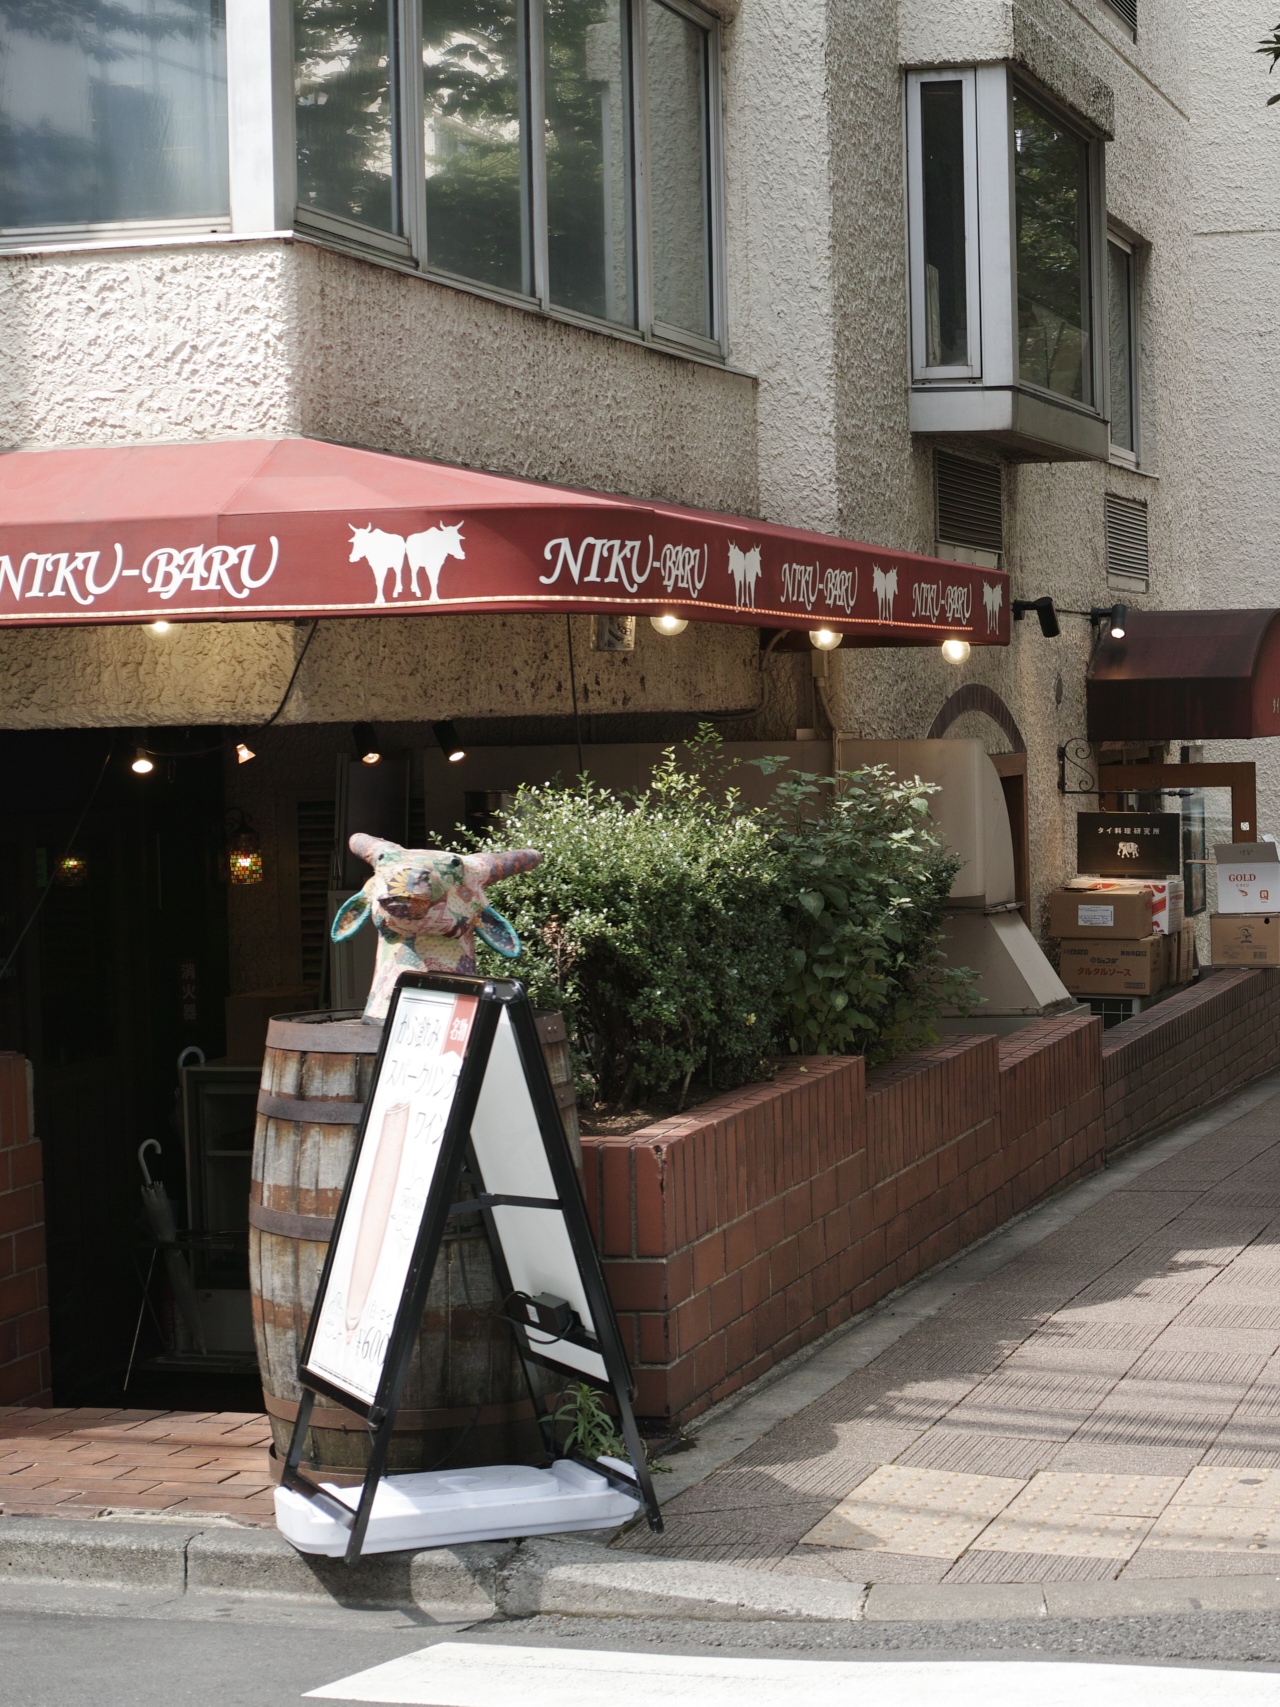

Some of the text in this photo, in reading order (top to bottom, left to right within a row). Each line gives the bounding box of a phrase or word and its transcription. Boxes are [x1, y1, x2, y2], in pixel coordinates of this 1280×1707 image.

[538, 534, 708, 598] NIKU-BARU
[780, 560, 859, 615] NIKU-BARU
[911, 582, 973, 625] NIKU-BARU
[1097, 827, 1160, 836] タイ料理研究所
[1228, 873, 1256, 882] GOLD
[1077, 967, 1132, 976] タルタルソース
[180, 963, 198, 1021] 消火器
[449, 1017, 469, 1042] 名物
[413, 1111, 446, 1145] ワイン
